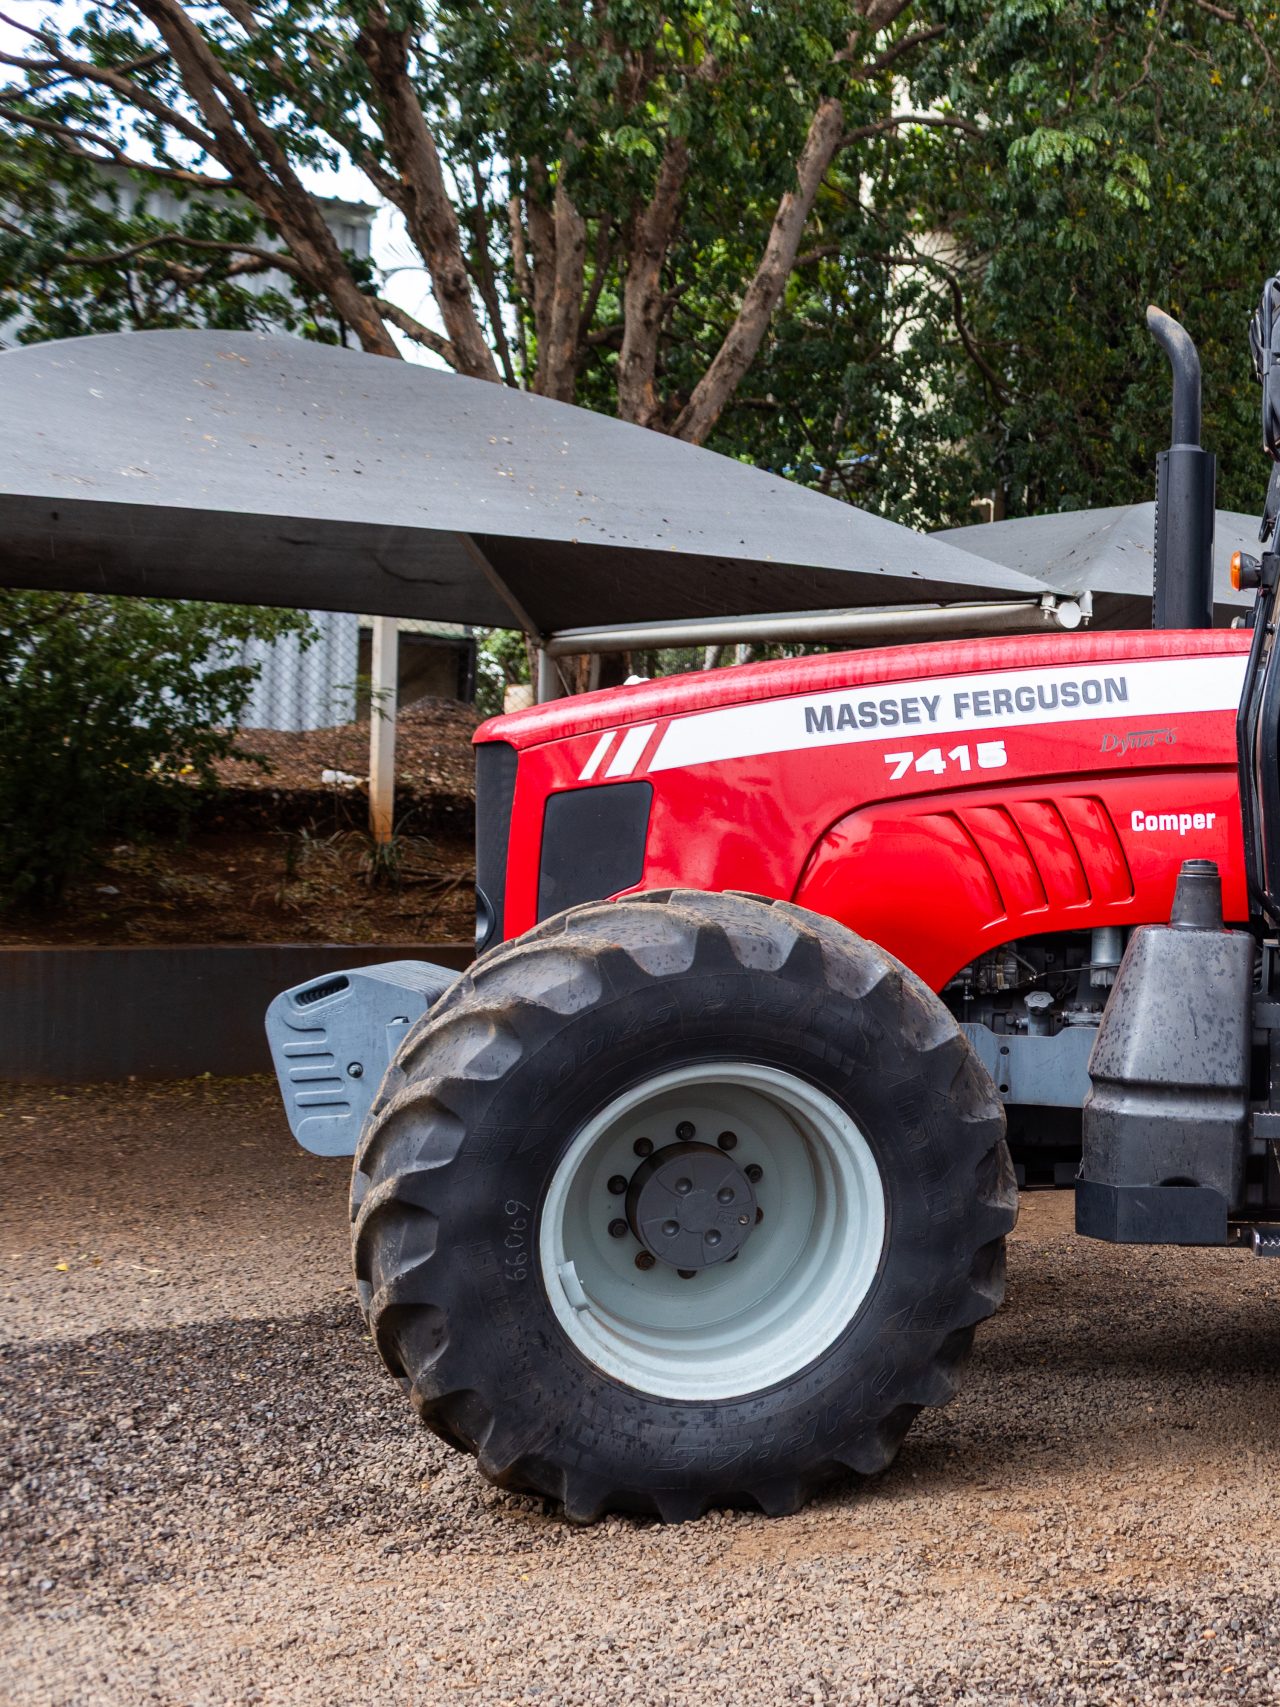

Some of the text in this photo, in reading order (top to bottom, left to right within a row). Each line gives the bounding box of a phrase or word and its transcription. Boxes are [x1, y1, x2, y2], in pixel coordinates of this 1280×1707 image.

[804, 676, 1128, 733] MASSEY FERGUSON
[1099, 727, 1178, 757] Dyna-6
[883, 740, 1009, 781] 7415
[1130, 809, 1216, 836] Comper
